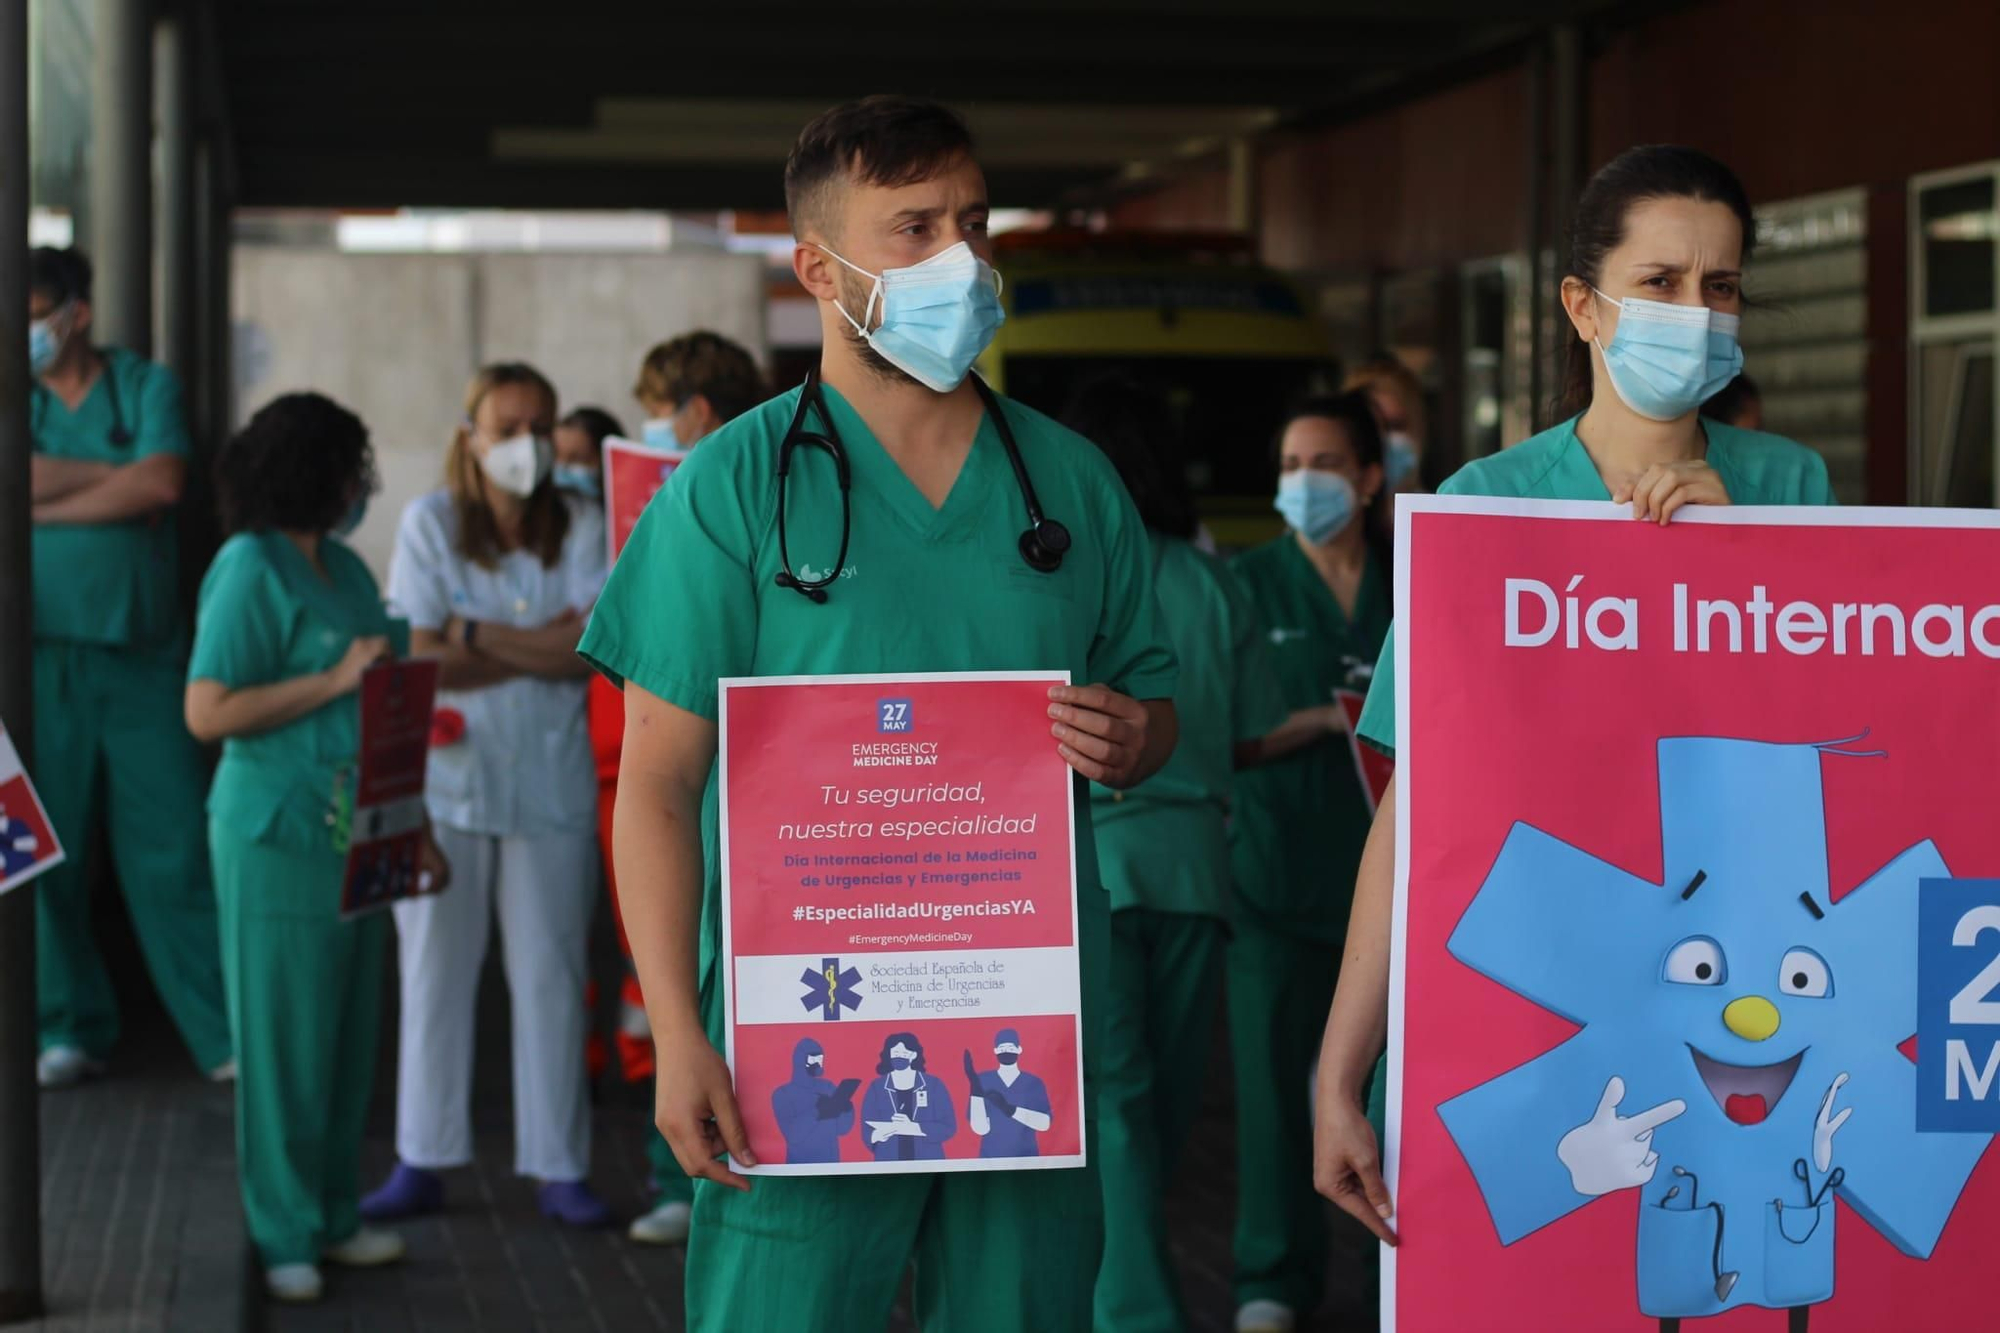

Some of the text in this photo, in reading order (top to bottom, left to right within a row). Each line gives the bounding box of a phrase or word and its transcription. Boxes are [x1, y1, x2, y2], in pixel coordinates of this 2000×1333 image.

[823, 565, 857, 578] Scyl
[1505, 574, 2000, 658] Día Internac
[883, 703, 907, 721] 27
[883, 721, 907, 731] MAY
[852, 742, 938, 756] EMERGENCY
[853, 755, 938, 767] MEDICINE DAY
[821, 781, 985, 808] Tu seguridad,
[778, 813, 1037, 841] nuestra especialidad
[784, 849, 1037, 867] Día Internacional de la Medicina
[801, 869, 1021, 889] de Urgencias y Emergencias
[792, 899, 1036, 924] #EspecialidadUrgenciasYA
[849, 932, 973, 946] #EmergencyMedicineDay
[870, 960, 1004, 979] Sociedad Española de
[1950, 905, 2000, 1024] 2
[871, 977, 1005, 996] Medicina de Urgencias
[897, 995, 981, 1013] y Emergencias
[1945, 1039, 2000, 1100] M
